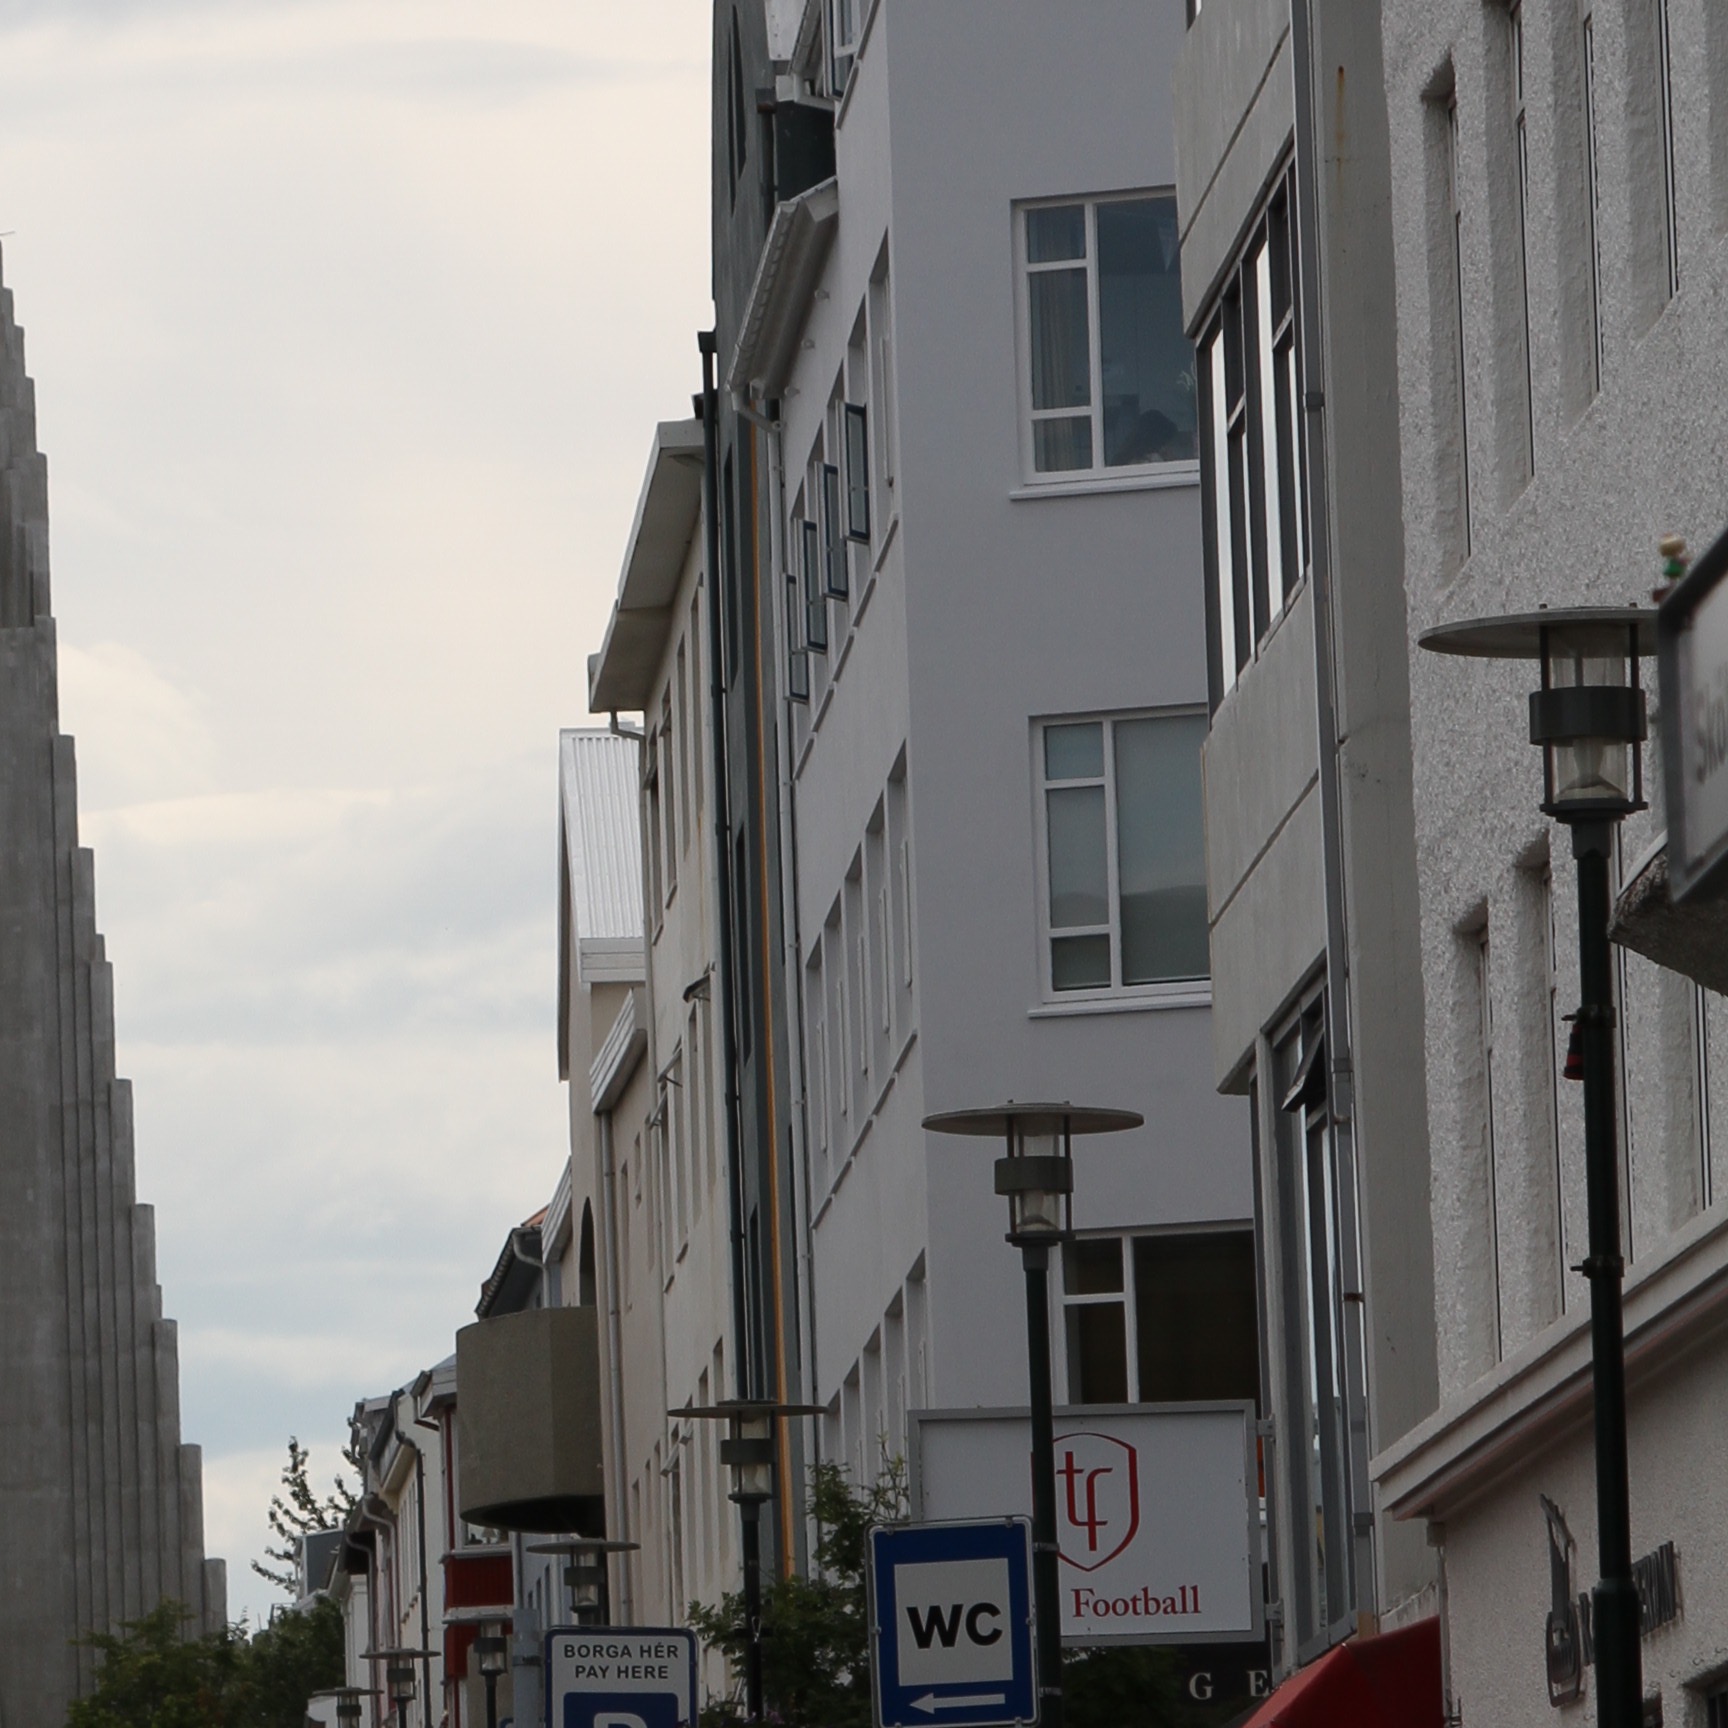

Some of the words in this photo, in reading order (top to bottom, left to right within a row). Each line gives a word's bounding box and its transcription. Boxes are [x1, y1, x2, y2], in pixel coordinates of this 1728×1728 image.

[1071, 1584, 1202, 1618] Football
[906, 1602, 1003, 1649] WC
[563, 1644, 632, 1659] BORGA
[639, 1642, 679, 1659] HÉR
[575, 1665, 610, 1679] PAY
[616, 1665, 669, 1679] HERE
